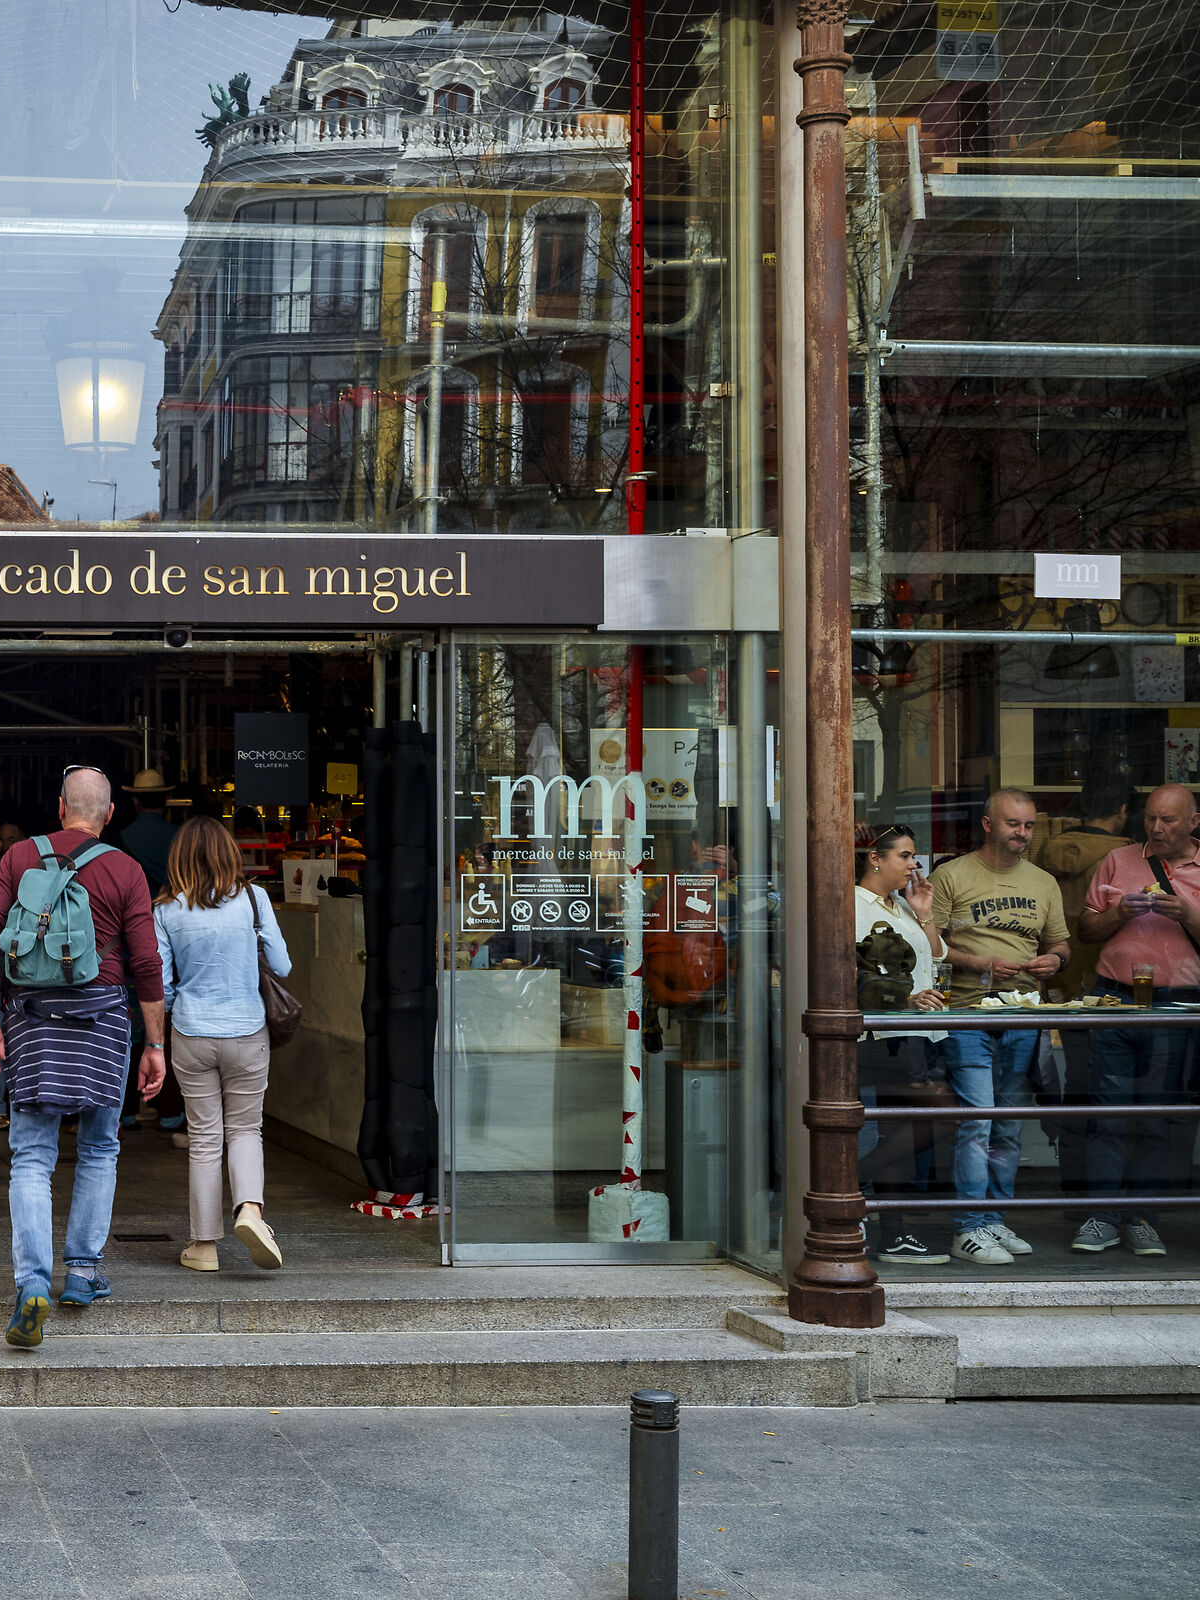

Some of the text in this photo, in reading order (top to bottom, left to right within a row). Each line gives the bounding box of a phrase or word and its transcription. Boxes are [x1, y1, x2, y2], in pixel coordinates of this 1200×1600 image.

[129, 549, 187, 595] de
[202, 565, 290, 597] san
[303, 551, 473, 613] miguel
[492, 846, 655, 862] mercado de san miel
[970, 897, 1036, 924] FISHING
